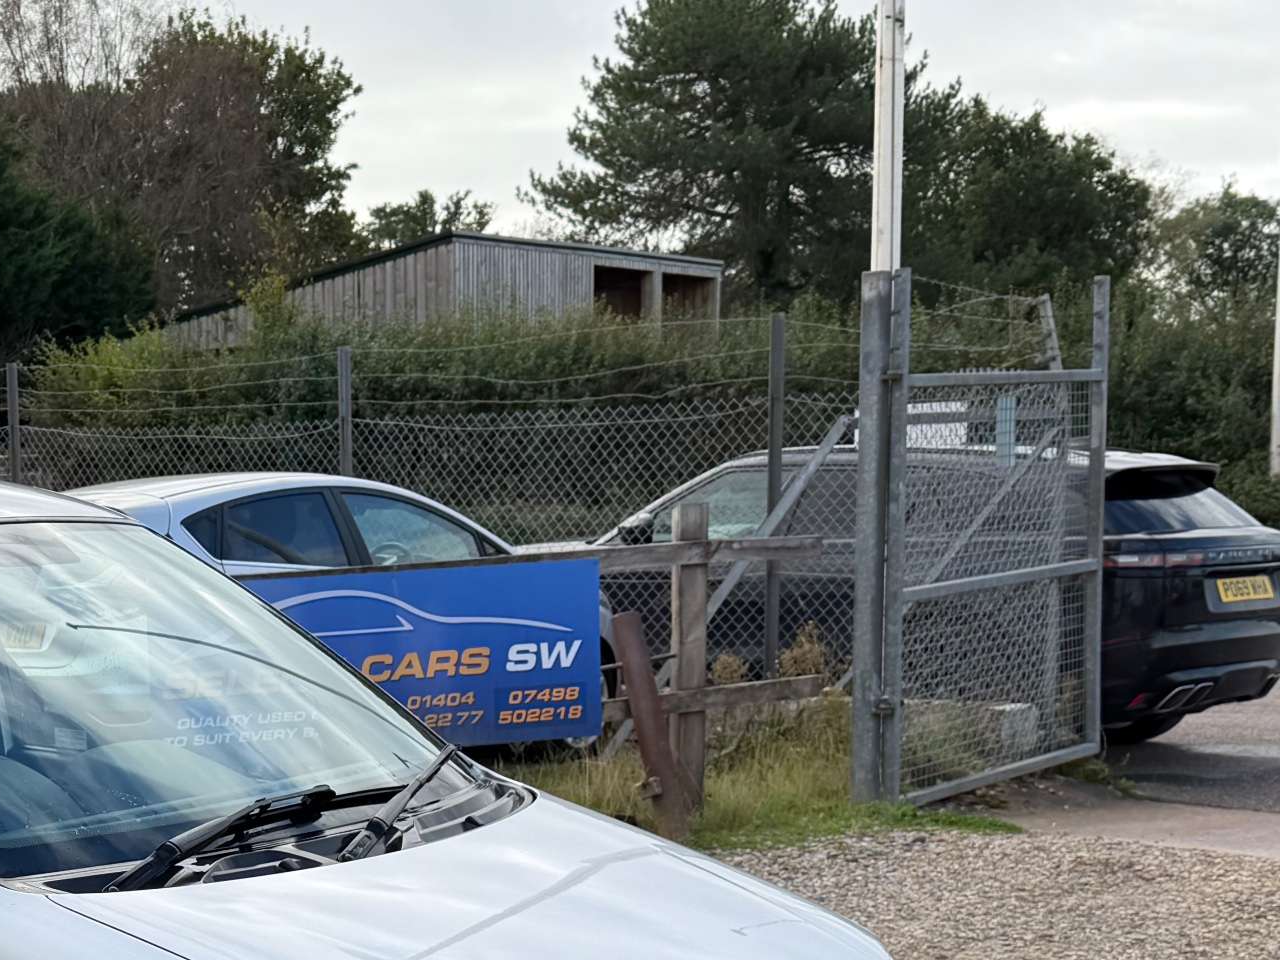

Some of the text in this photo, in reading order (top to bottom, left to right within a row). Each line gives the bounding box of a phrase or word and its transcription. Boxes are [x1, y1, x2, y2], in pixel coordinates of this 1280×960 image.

[361, 640, 582, 682] CARS SW
[407, 692, 475, 710] 01404
[508, 687, 580, 705] 07498
[177, 714, 254, 730] QUALITY
[257, 711, 306, 724] USED
[498, 705, 582, 725] 502218
[193, 731, 236, 746] SUIT
[239, 726, 299, 742] EVERY
